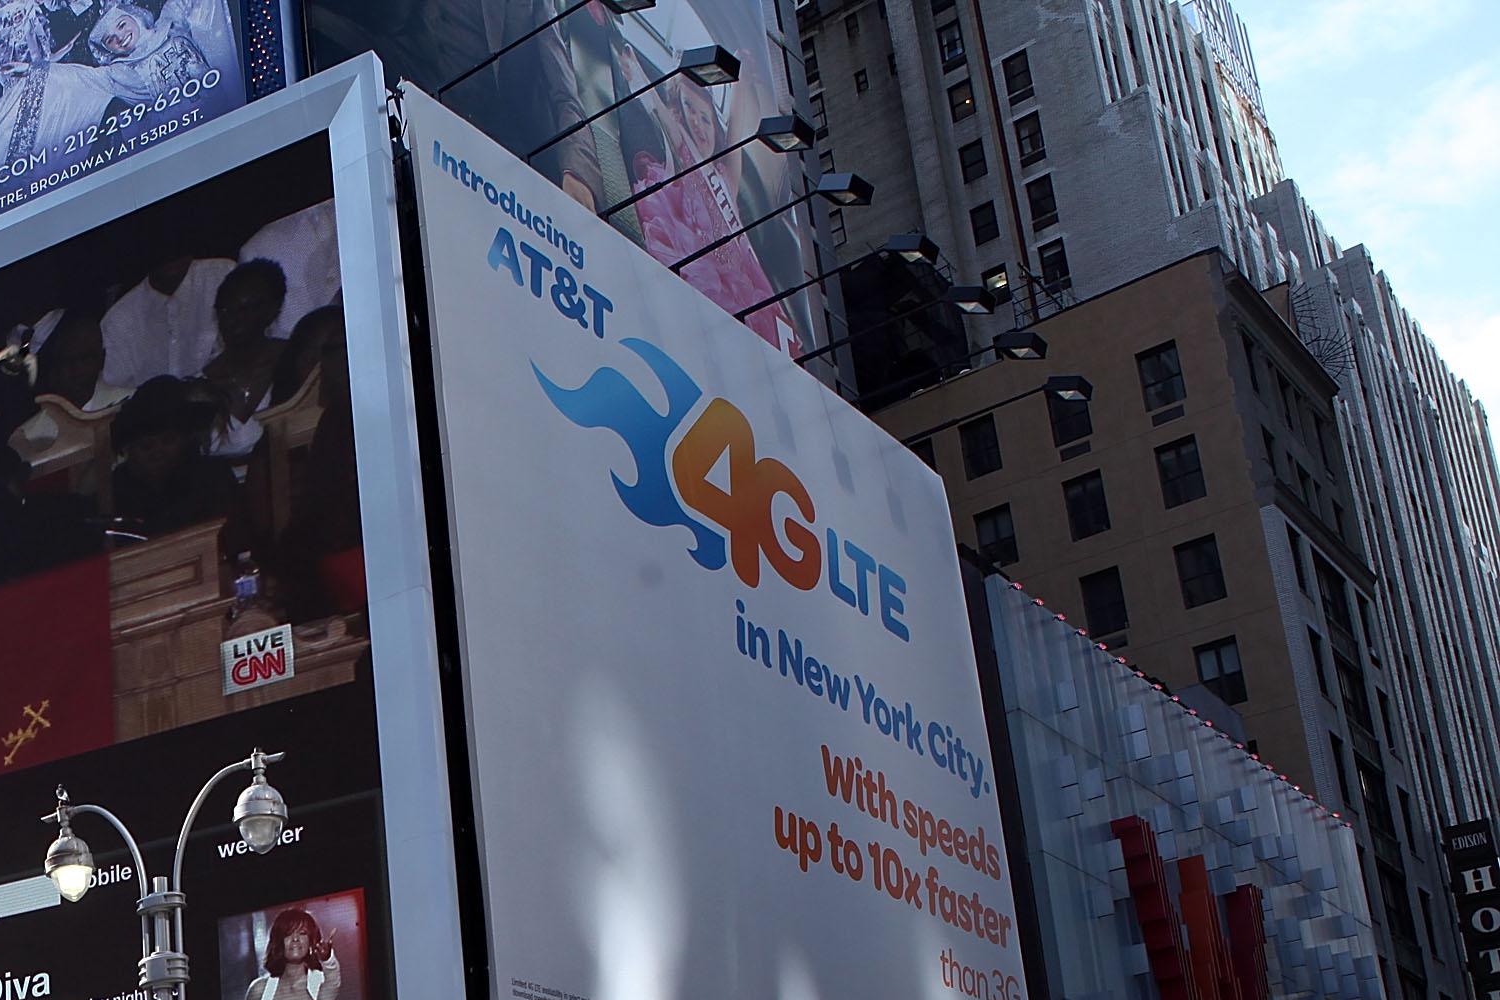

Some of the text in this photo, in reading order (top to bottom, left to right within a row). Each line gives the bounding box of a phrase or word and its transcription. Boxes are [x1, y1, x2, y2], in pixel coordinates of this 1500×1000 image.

[30, 148, 114, 195] BROADWAY
[118, 137, 136, 156] AT
[140, 119, 178, 147] 53RD
[182, 110, 204, 127] ST.
[65, 69, 221, 154] 212-239-6200
[433, 140, 584, 270] Introducing
[487, 227, 613, 338] AT&T
[672, 398, 910, 642] 4G LTE
[231, 648, 286, 686] CNN
[233, 631, 284, 659] LIVE
[736, 600, 990, 799] in New York City.
[821, 745, 1000, 881] With speeds
[1452, 831, 1487, 850] EDISON
[774, 806, 1010, 948] up to 10x faster
